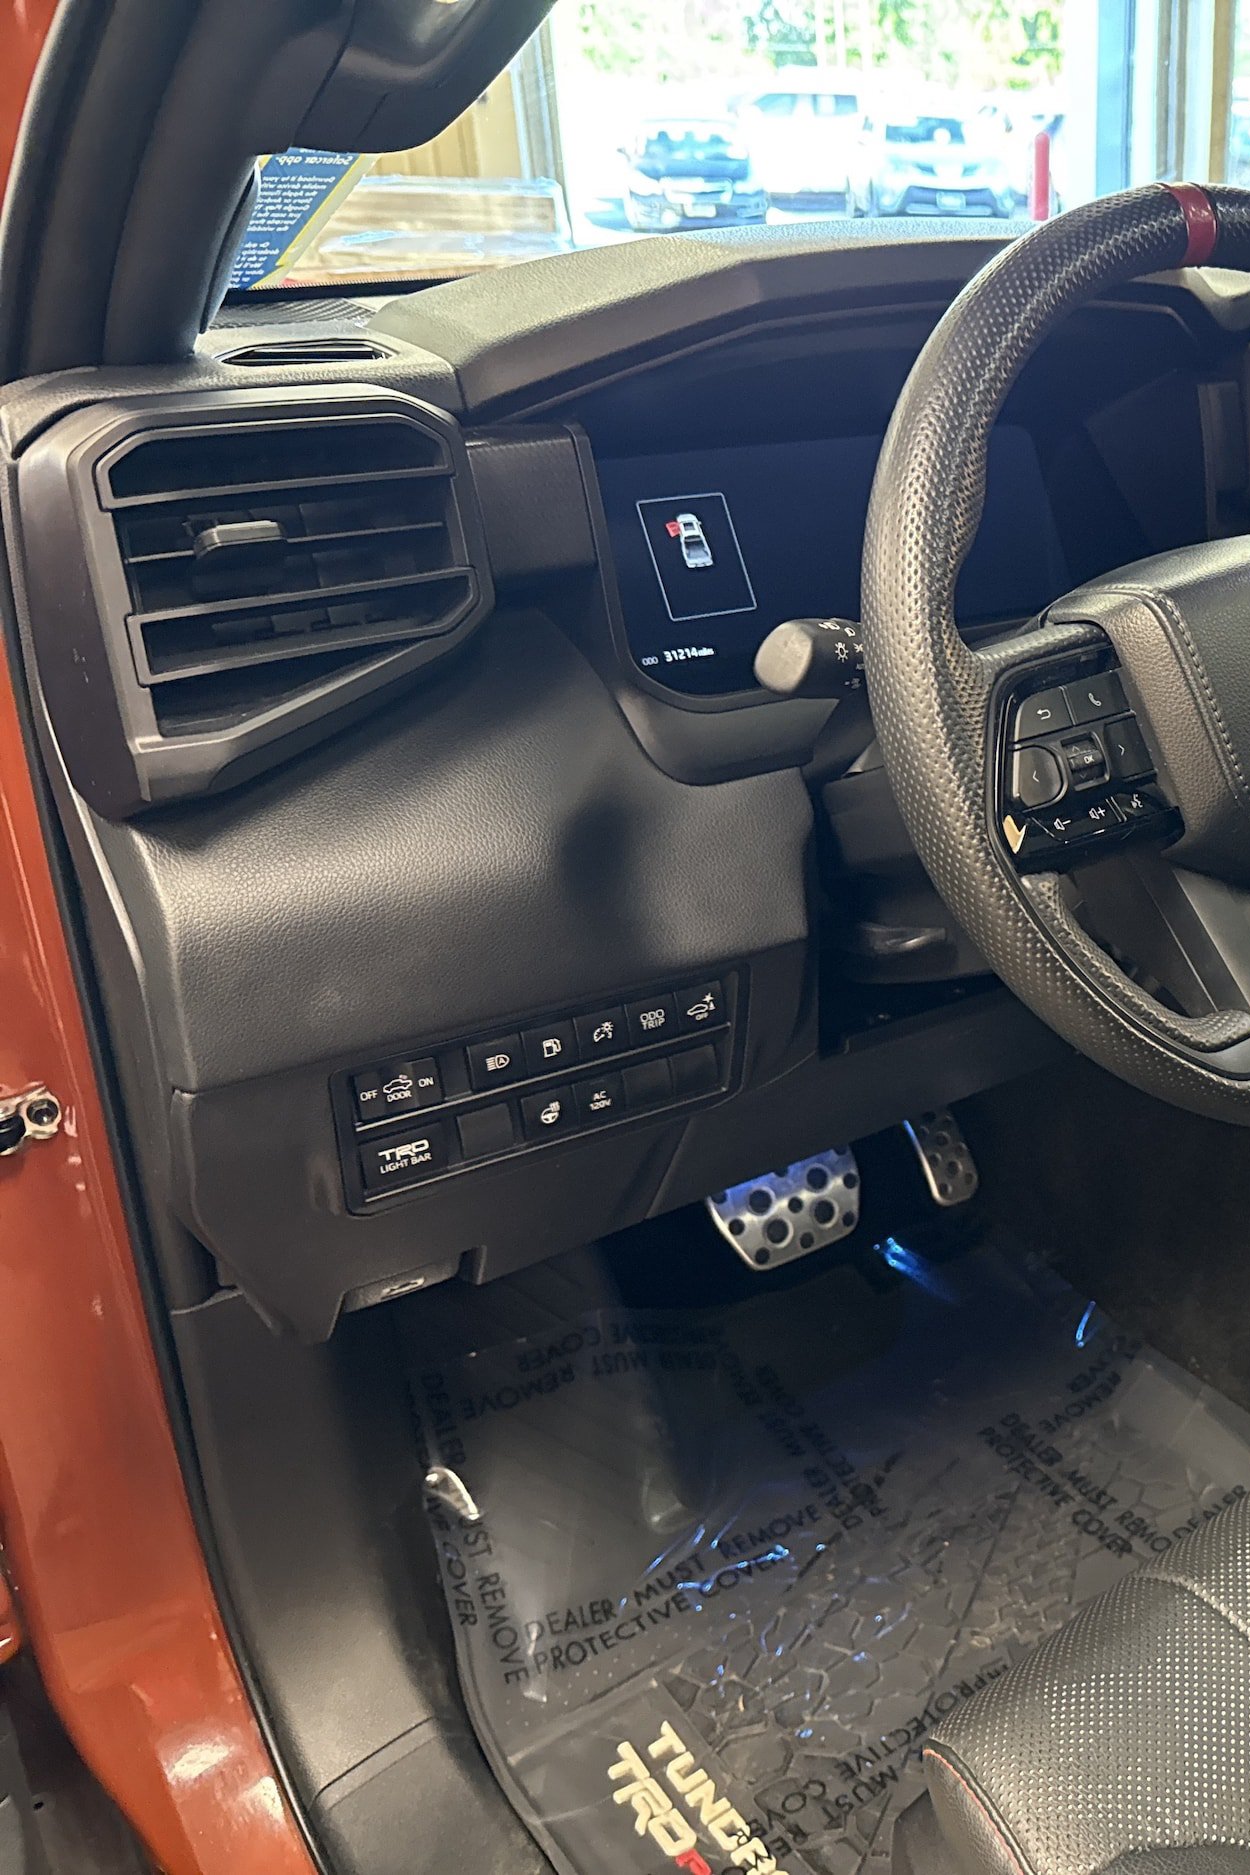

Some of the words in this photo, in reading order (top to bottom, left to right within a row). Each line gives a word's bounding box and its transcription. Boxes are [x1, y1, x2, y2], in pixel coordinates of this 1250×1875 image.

[639, 1008, 665, 1023] ODO
[641, 1016, 666, 1030] TRIP
[695, 1011, 709, 1021] OFF
[360, 1089, 378, 1101] OFF
[386, 1089, 412, 1102] DOOR
[418, 1076, 434, 1088] ON
[593, 1090, 606, 1101] AC
[589, 1098, 612, 1110] 120V
[378, 1139, 430, 1161] TRD
[380, 1157, 408, 1174] LIGHT
[410, 1151, 432, 1166] BAR
[1063, 1468, 1119, 1511] MUST
[1117, 1510, 1174, 1554] REMO
[1072, 1508, 1134, 1559] COVER
[441, 1541, 478, 1627] COVER
[525, 1599, 618, 1640] DEALER
[633, 1552, 706, 1607] MUST
[717, 1503, 822, 1558] REMOVE
[477, 1571, 530, 1684] REMOVE
[533, 1590, 691, 1675] PROTECTIVE
[834, 1674, 988, 1781] PROTECTIVE
[647, 1719, 791, 1875] TUNDR
[736, 1779, 827, 1848] COVER
[823, 1764, 899, 1831] MUST
